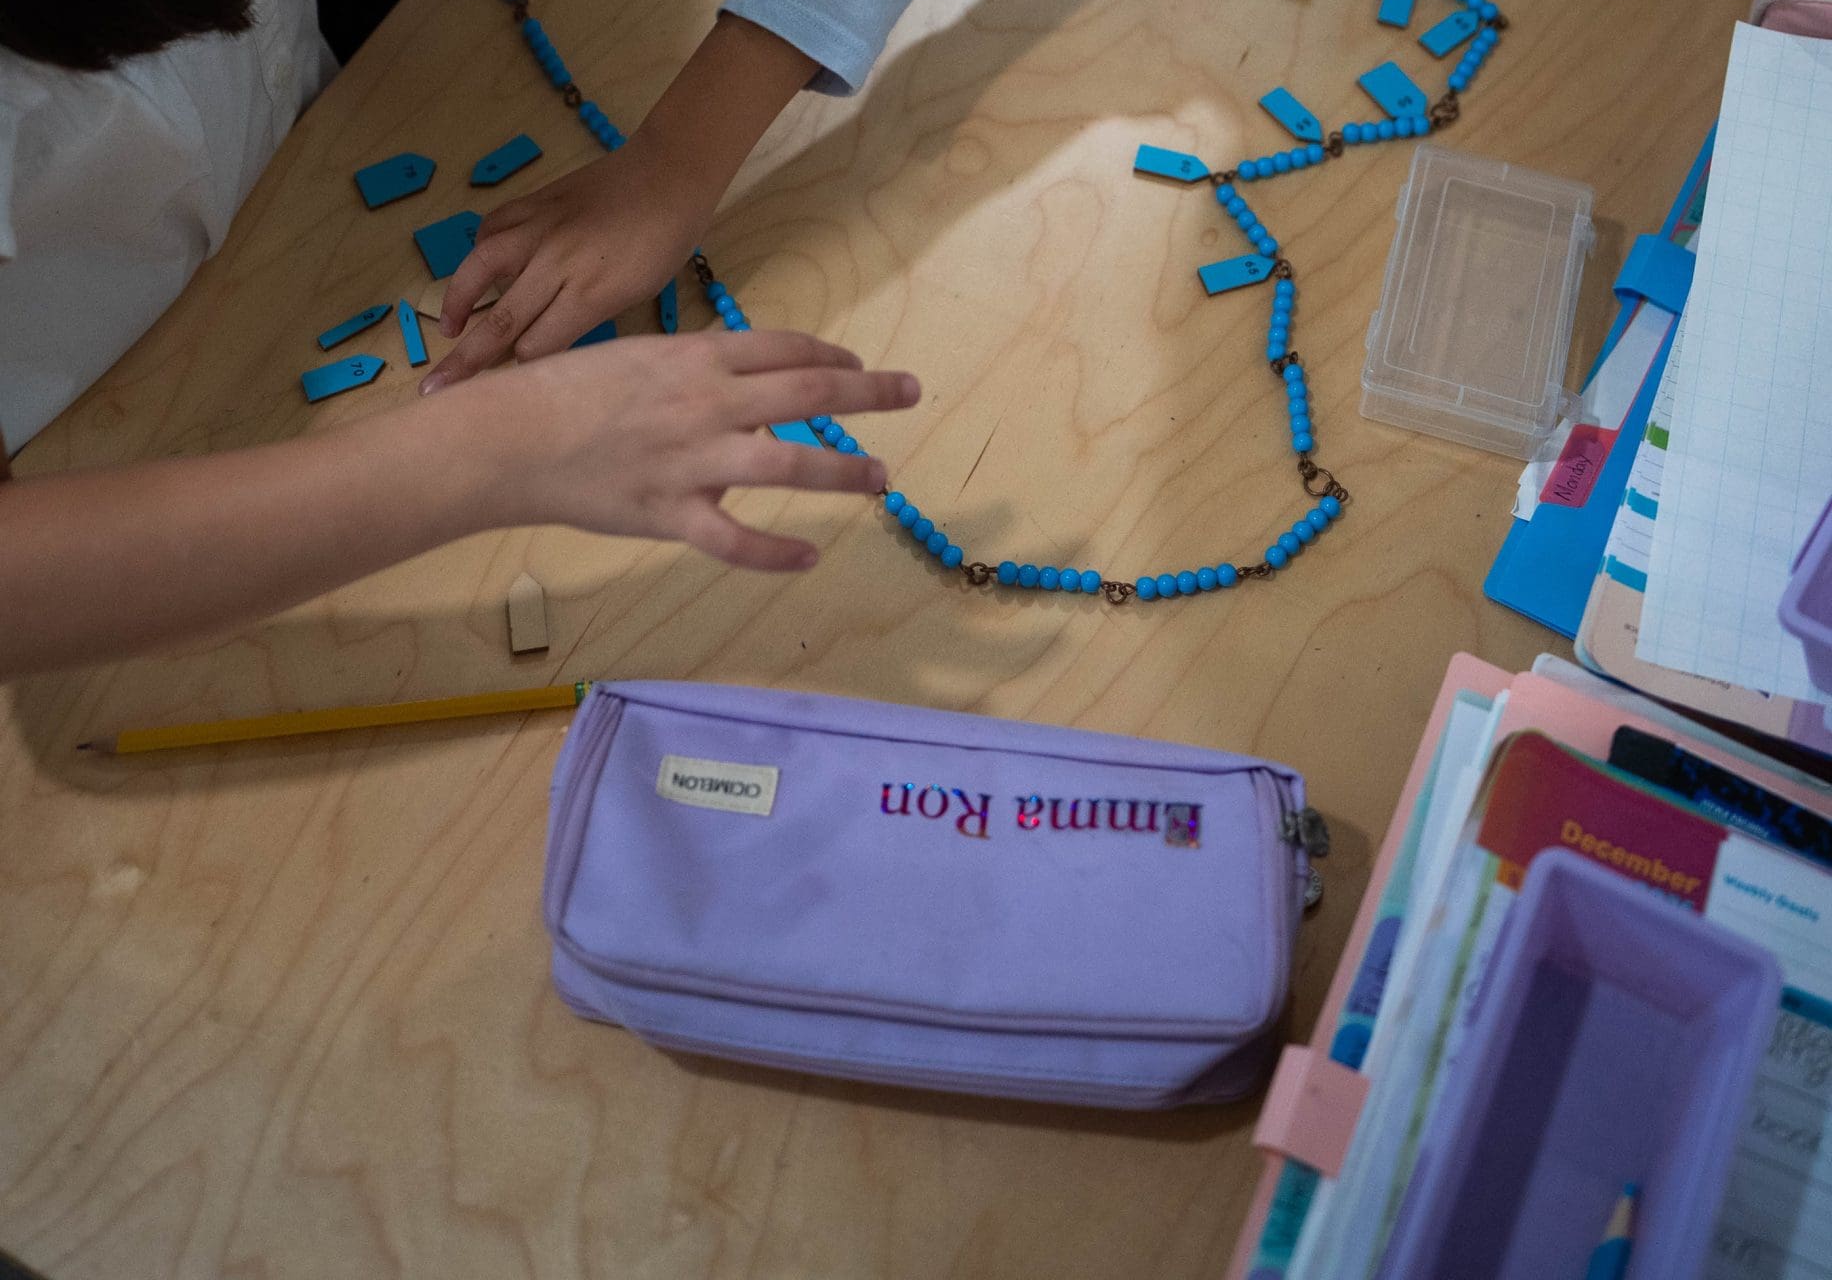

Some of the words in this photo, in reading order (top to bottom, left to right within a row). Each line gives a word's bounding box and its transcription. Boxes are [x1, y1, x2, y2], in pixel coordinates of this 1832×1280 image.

[350, 360, 365, 377] 70
[1553, 453, 1594, 503] Monday
[878, 782, 993, 840] Ron
[1014, 795, 1204, 850] Emma
[1561, 819, 1702, 895] December
